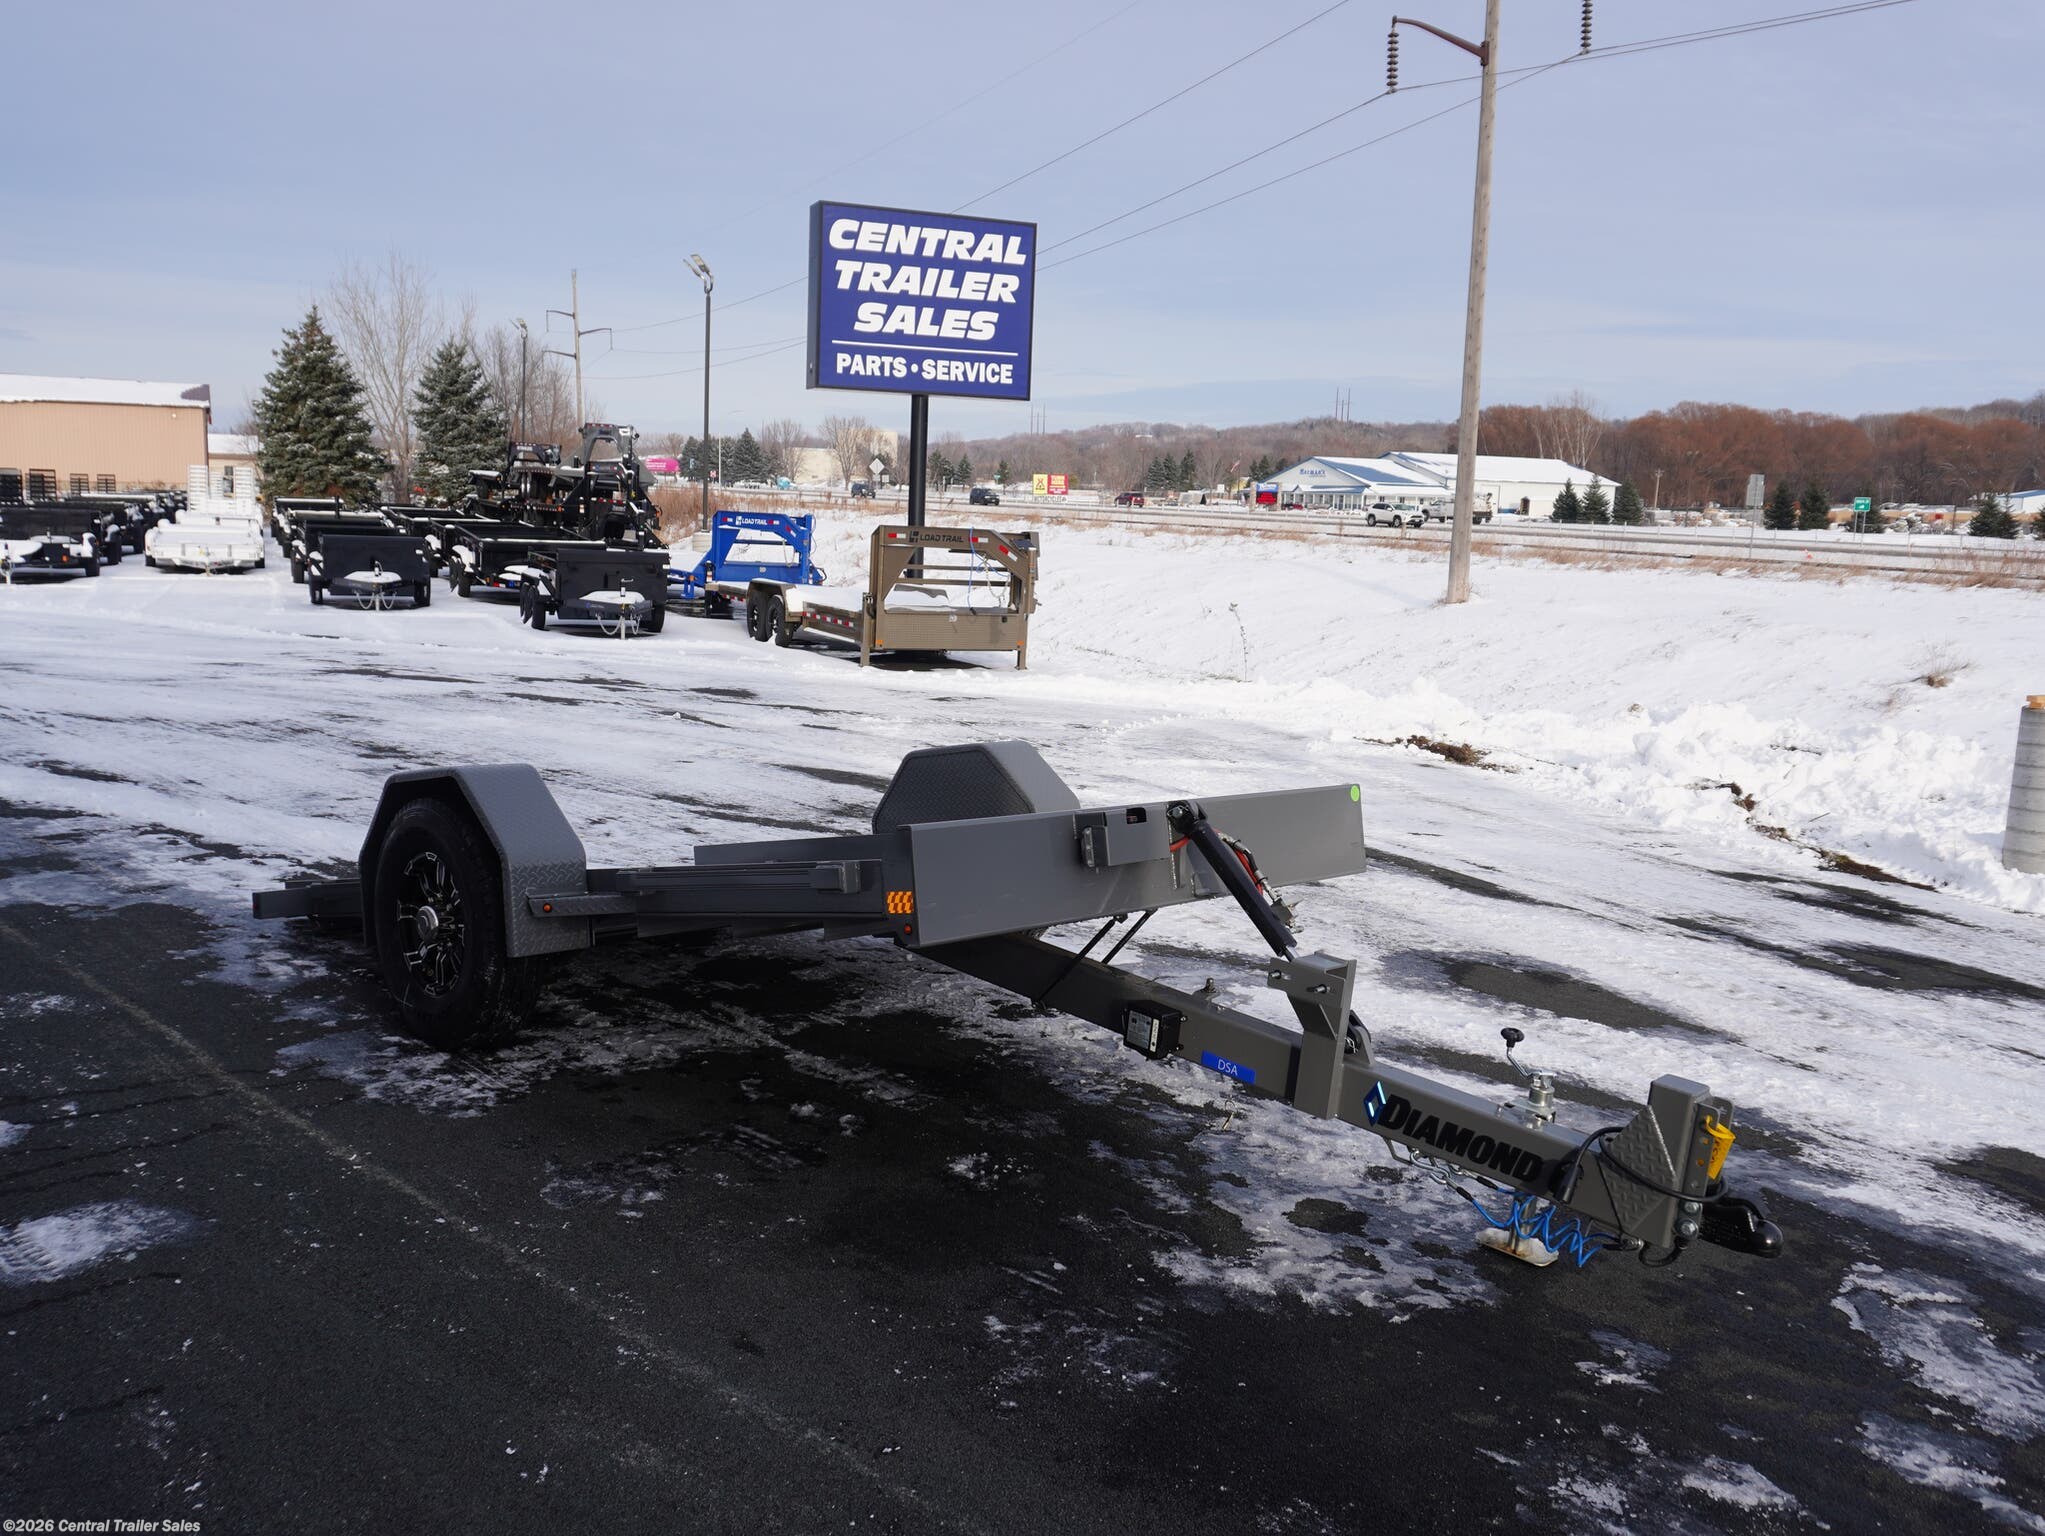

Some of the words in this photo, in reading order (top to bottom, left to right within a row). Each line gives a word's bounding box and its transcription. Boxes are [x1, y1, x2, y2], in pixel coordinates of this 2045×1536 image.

[829, 218, 1027, 265] CENTRAL
[835, 260, 1020, 304] TRAILER
[853, 302, 999, 341] SALES
[836, 353, 907, 378] PARTS
[921, 358, 1013, 384] SERVICE
[1217, 1058, 1238, 1077] DSA
[1377, 1094, 1545, 1182] DIAMOND
